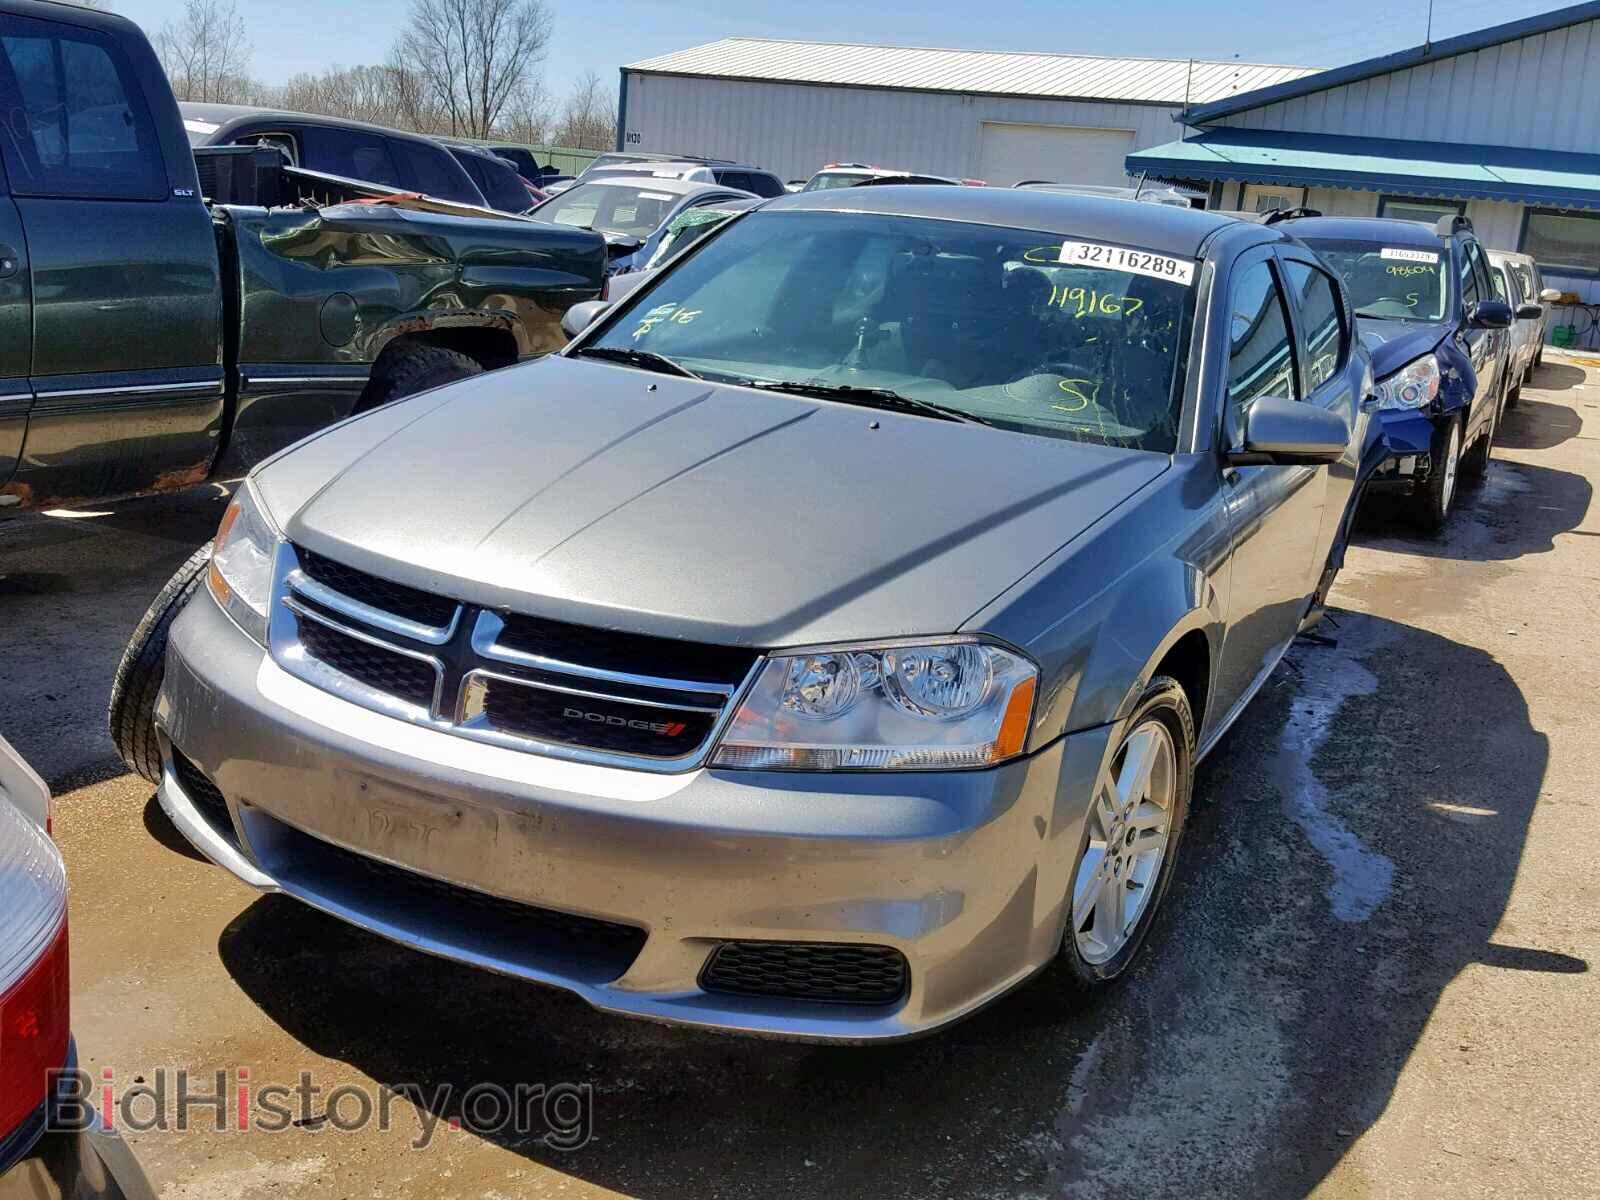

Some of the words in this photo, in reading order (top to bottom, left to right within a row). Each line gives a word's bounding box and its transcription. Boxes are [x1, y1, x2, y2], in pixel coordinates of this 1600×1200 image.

[174, 189, 194, 197] SLT
[1052, 379, 1088, 411] S
[563, 707, 668, 734] DODGE
